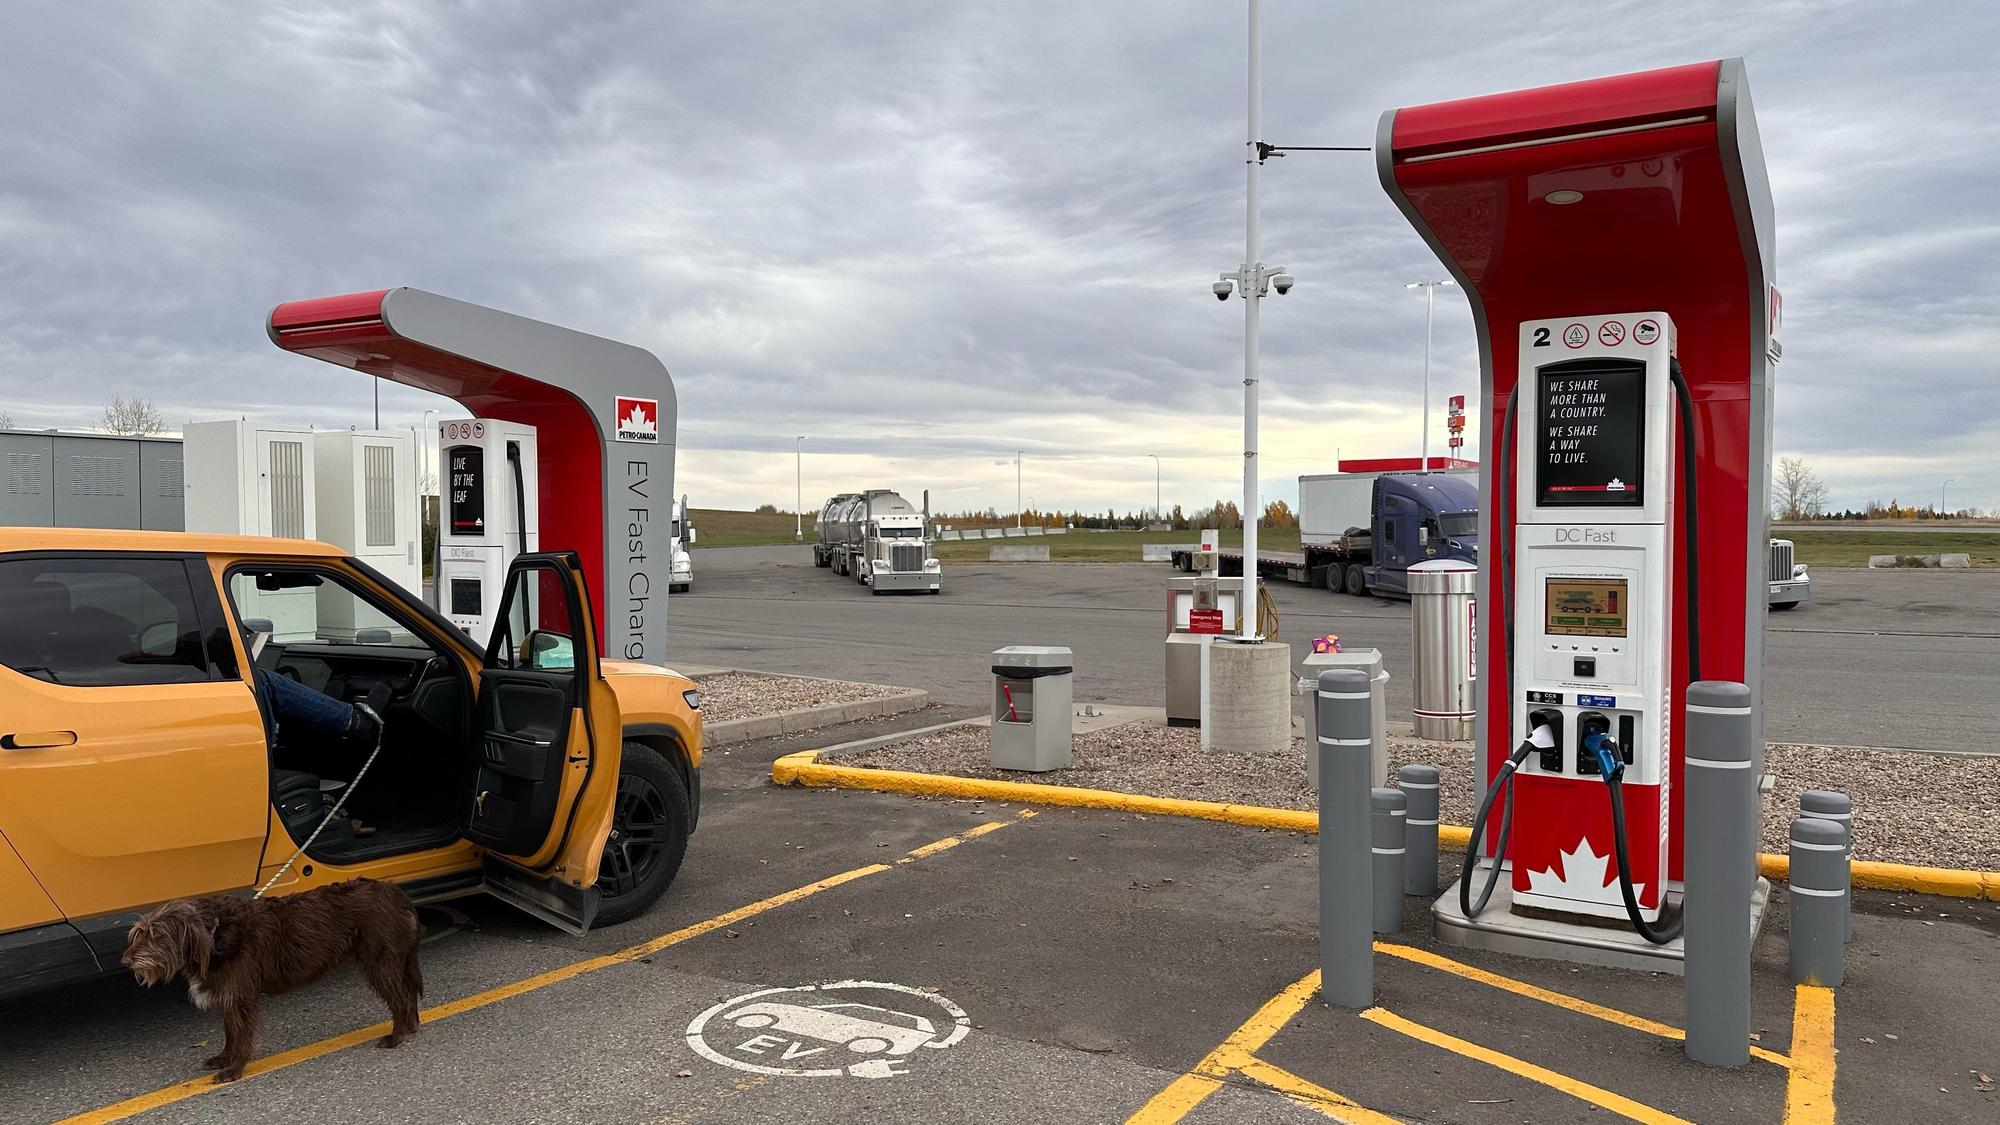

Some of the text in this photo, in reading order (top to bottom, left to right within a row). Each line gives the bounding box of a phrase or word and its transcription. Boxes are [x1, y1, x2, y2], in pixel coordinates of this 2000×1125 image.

[1533, 327, 1551, 347] 2
[1550, 379, 1599, 392] WE SHARE
[1550, 393, 1606, 406] MORE THAN
[1550, 406, 1606, 419] A COUNTRY.
[440, 426, 444, 439] 1
[1549, 425, 1598, 437] WE SHARE
[1549, 439, 1580, 450] A WAY
[453, 457, 466, 470] LIVE
[1549, 452, 1588, 464] TO LIVE.
[453, 473, 475, 487] BY THE
[627, 461, 648, 498] EV
[453, 490, 467, 503] LEAF
[628, 508, 648, 564] Fast
[1555, 528, 1616, 543] DC Fast
[450, 548, 474, 558] DC Fast
[735, 1034, 826, 1061] EV
